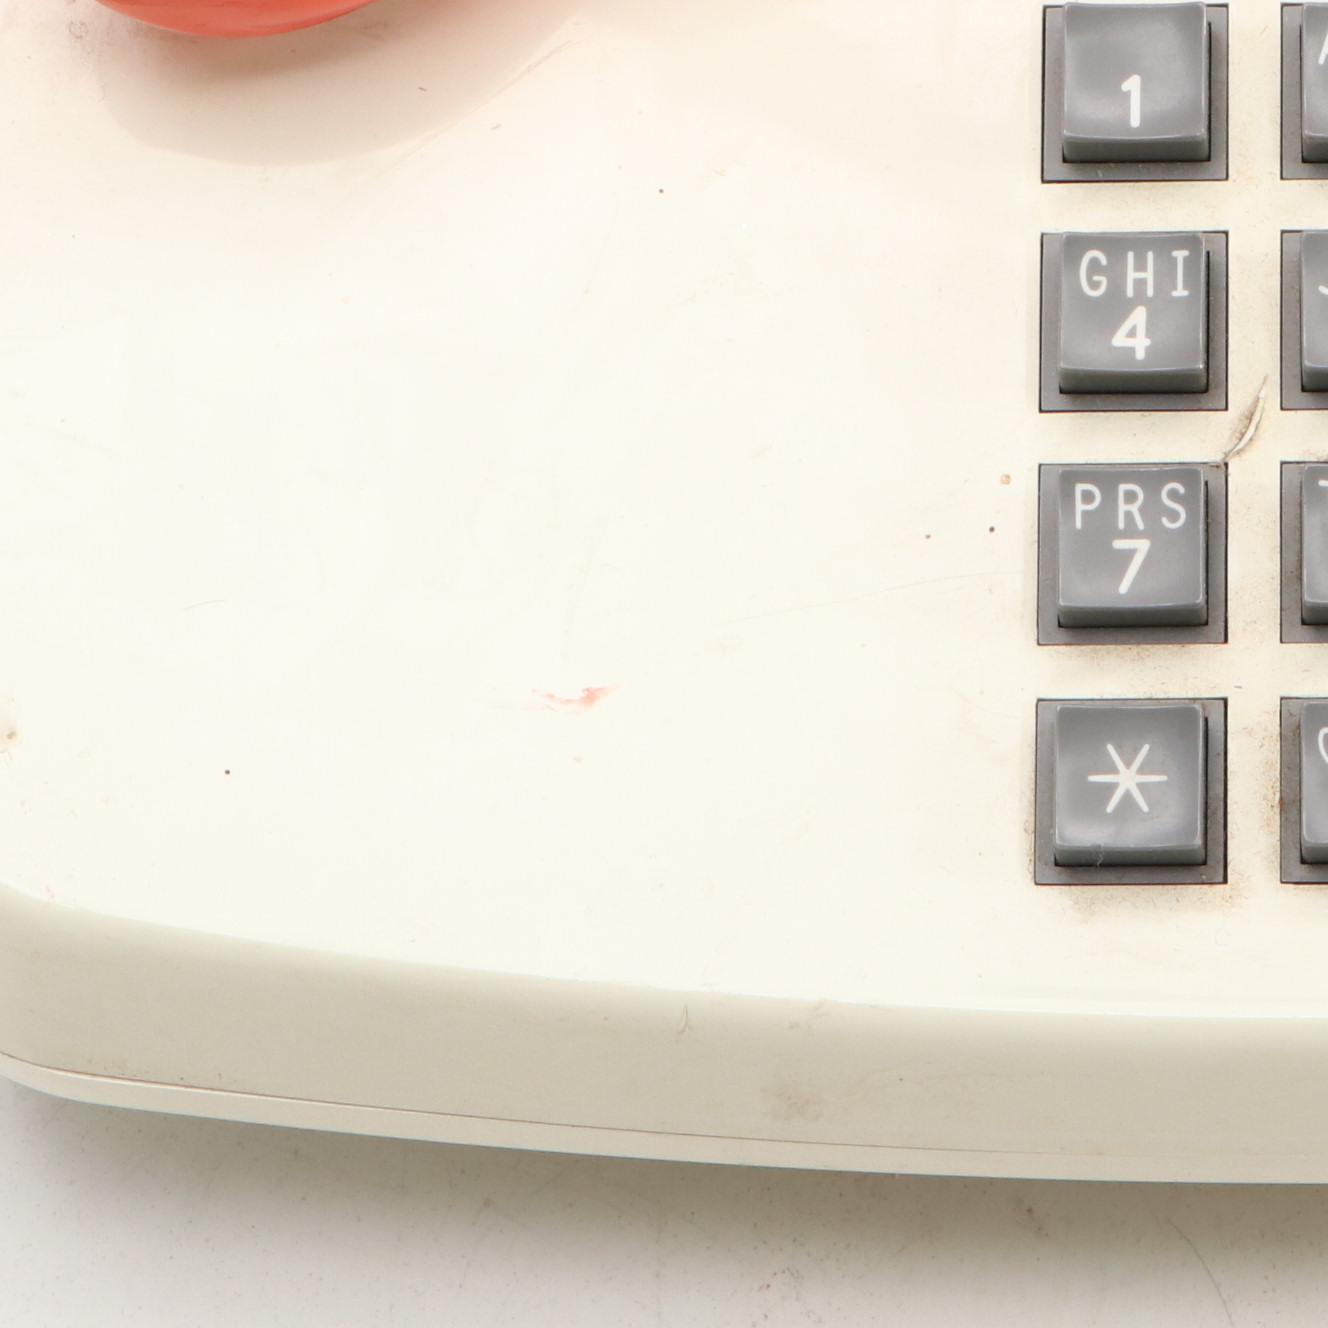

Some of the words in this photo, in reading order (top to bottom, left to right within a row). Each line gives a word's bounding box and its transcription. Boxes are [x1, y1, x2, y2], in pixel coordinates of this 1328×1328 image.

[1120, 74, 1142, 128] 1
[1078, 249, 1190, 299] GHI
[1109, 304, 1152, 361] 4
[1074, 482, 1187, 531] PRS
[1111, 537, 1152, 595] 7
